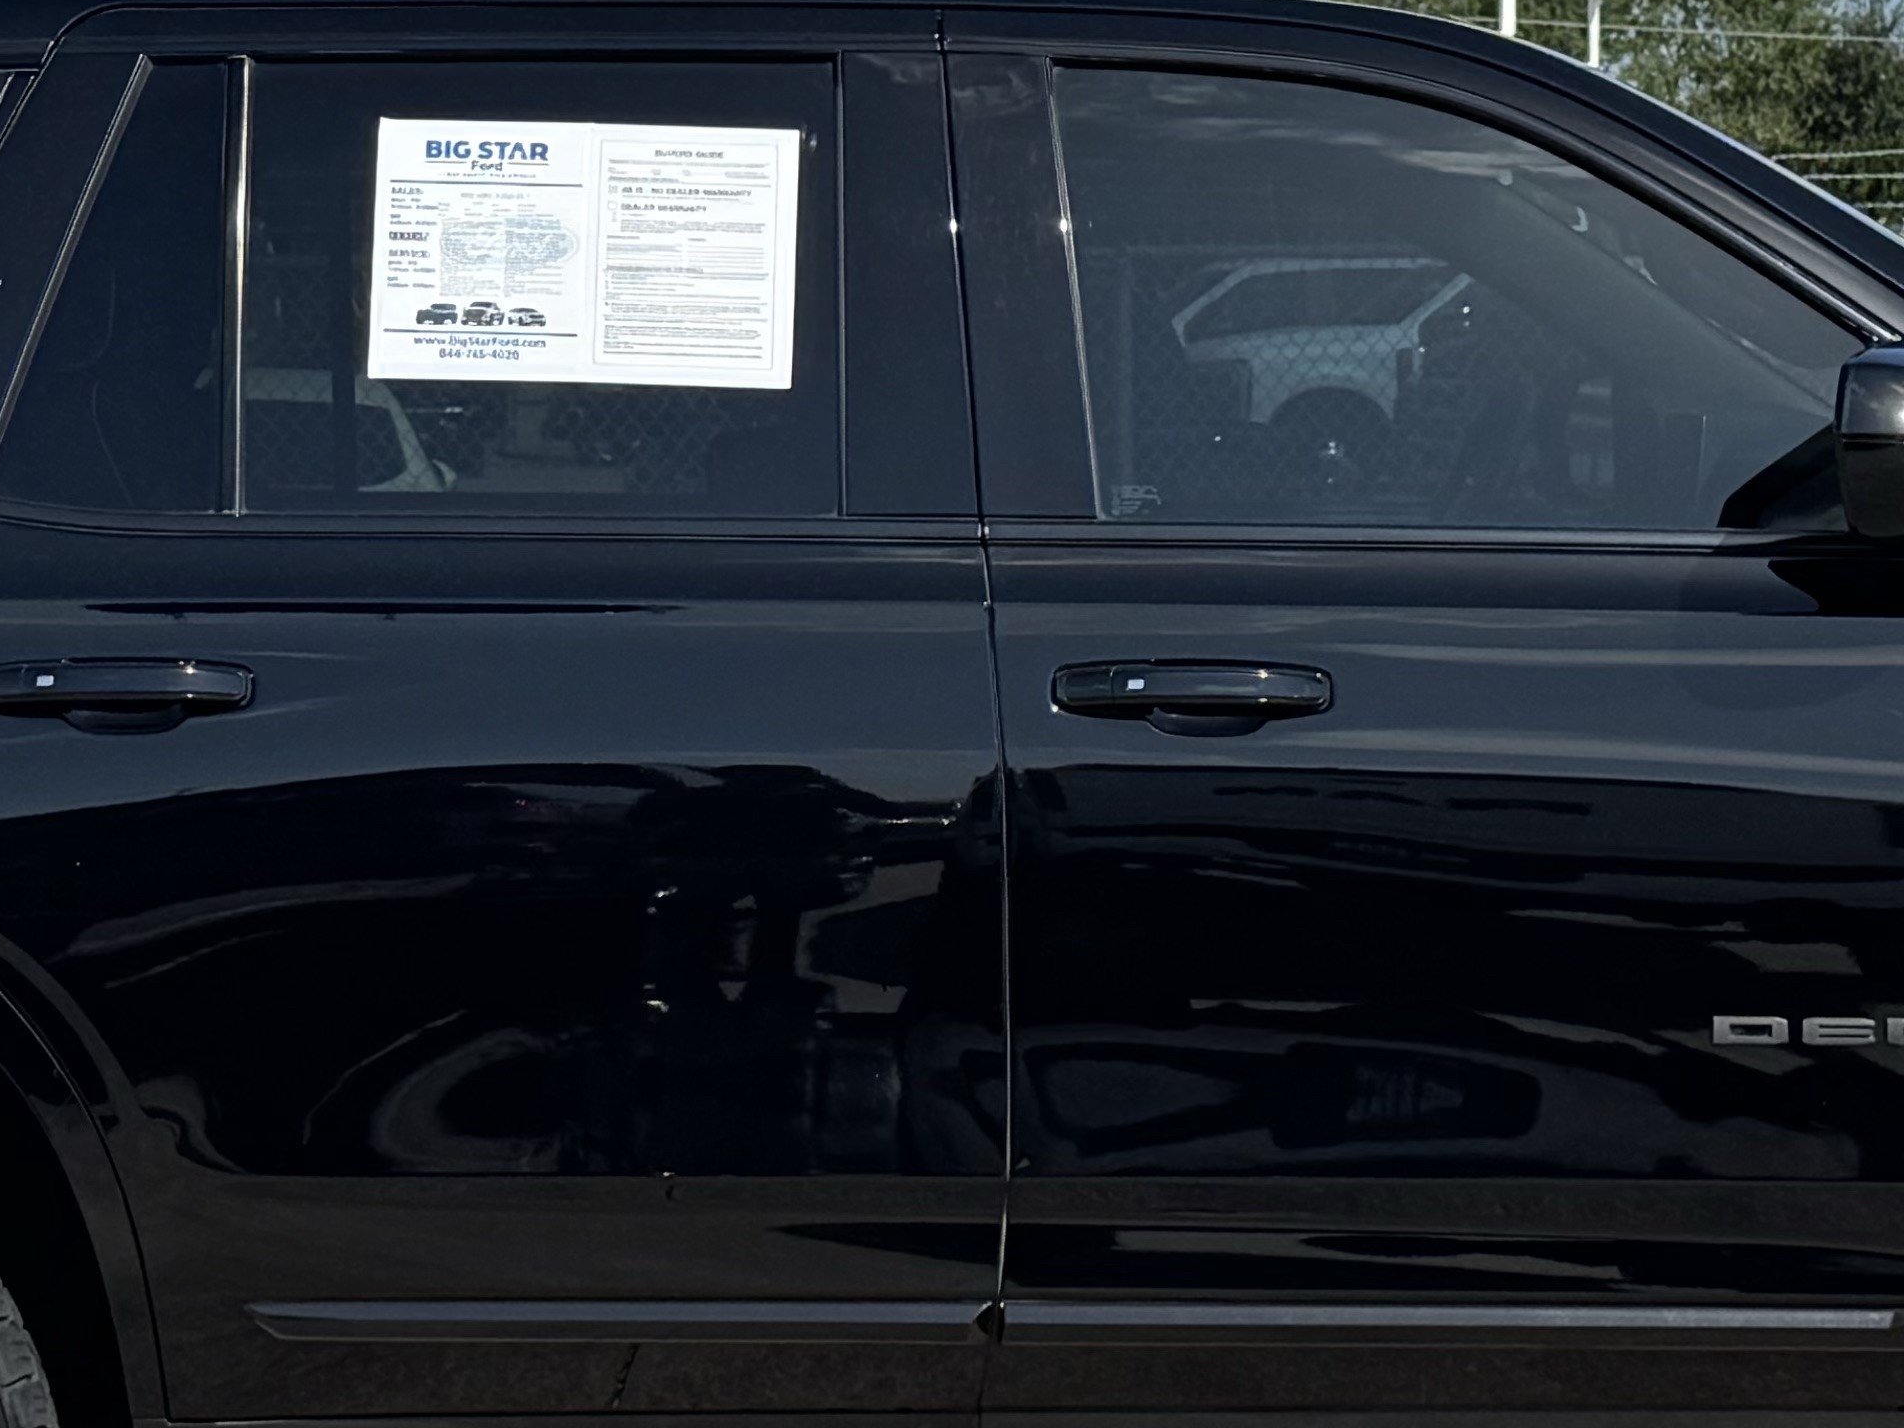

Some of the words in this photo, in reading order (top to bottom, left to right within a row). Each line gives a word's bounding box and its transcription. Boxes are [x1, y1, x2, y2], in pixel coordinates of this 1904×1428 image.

[425, 140, 471, 159] BIG
[478, 141, 549, 161] STAR
[471, 160, 503, 171] Ford
